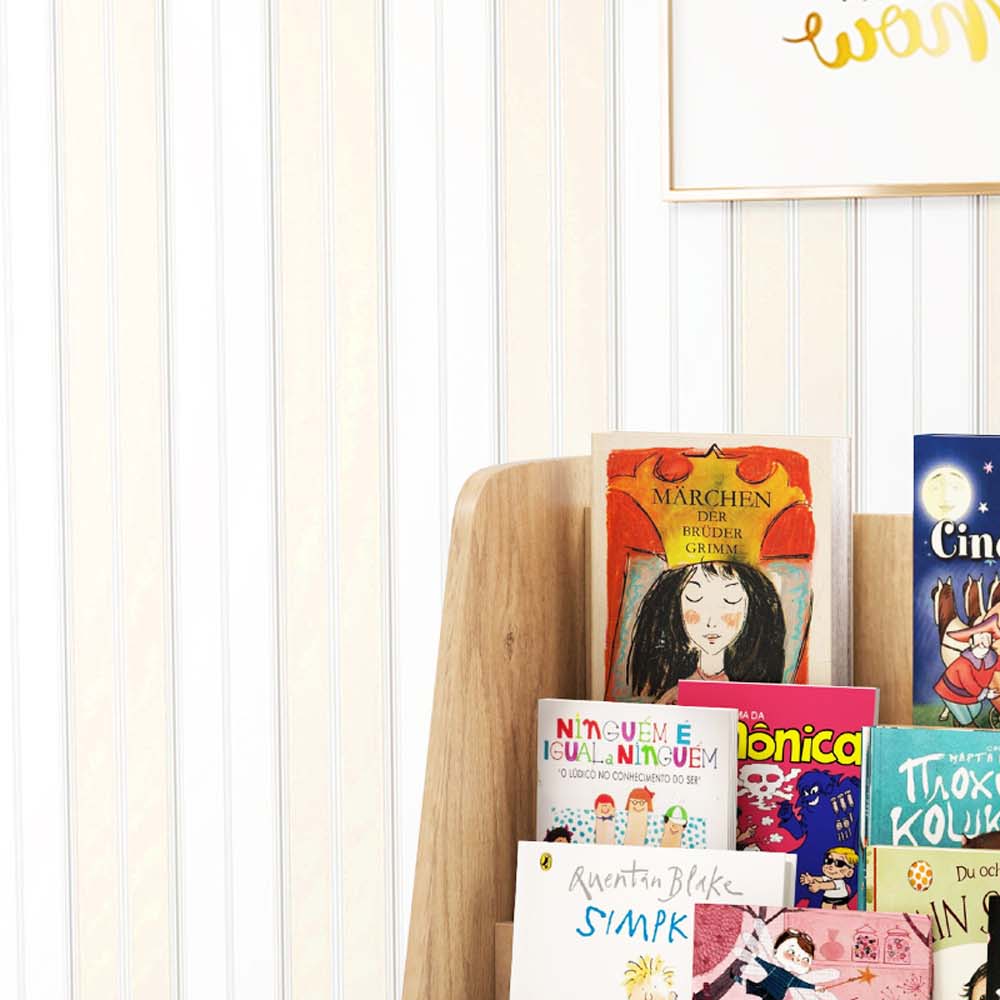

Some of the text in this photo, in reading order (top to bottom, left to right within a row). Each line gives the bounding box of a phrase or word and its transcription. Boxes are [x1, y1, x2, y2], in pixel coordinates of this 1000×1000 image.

[652, 486, 772, 508] MÄRCHEN
[697, 510, 727, 523] DER
[682, 525, 743, 540] BRÜDER
[685, 543, 738, 555] GRIMM
[750, 711, 765, 720] DA
[543, 739, 604, 765] IGUAL
[598, 770, 611, 781] NO
[612, 771, 671, 784] CONHECIMENTO
[672, 774, 684, 784] DO
[568, 859, 744, 902] Quentin Blake
[956, 865, 975, 882] Du
[929, 895, 968, 943] IN
